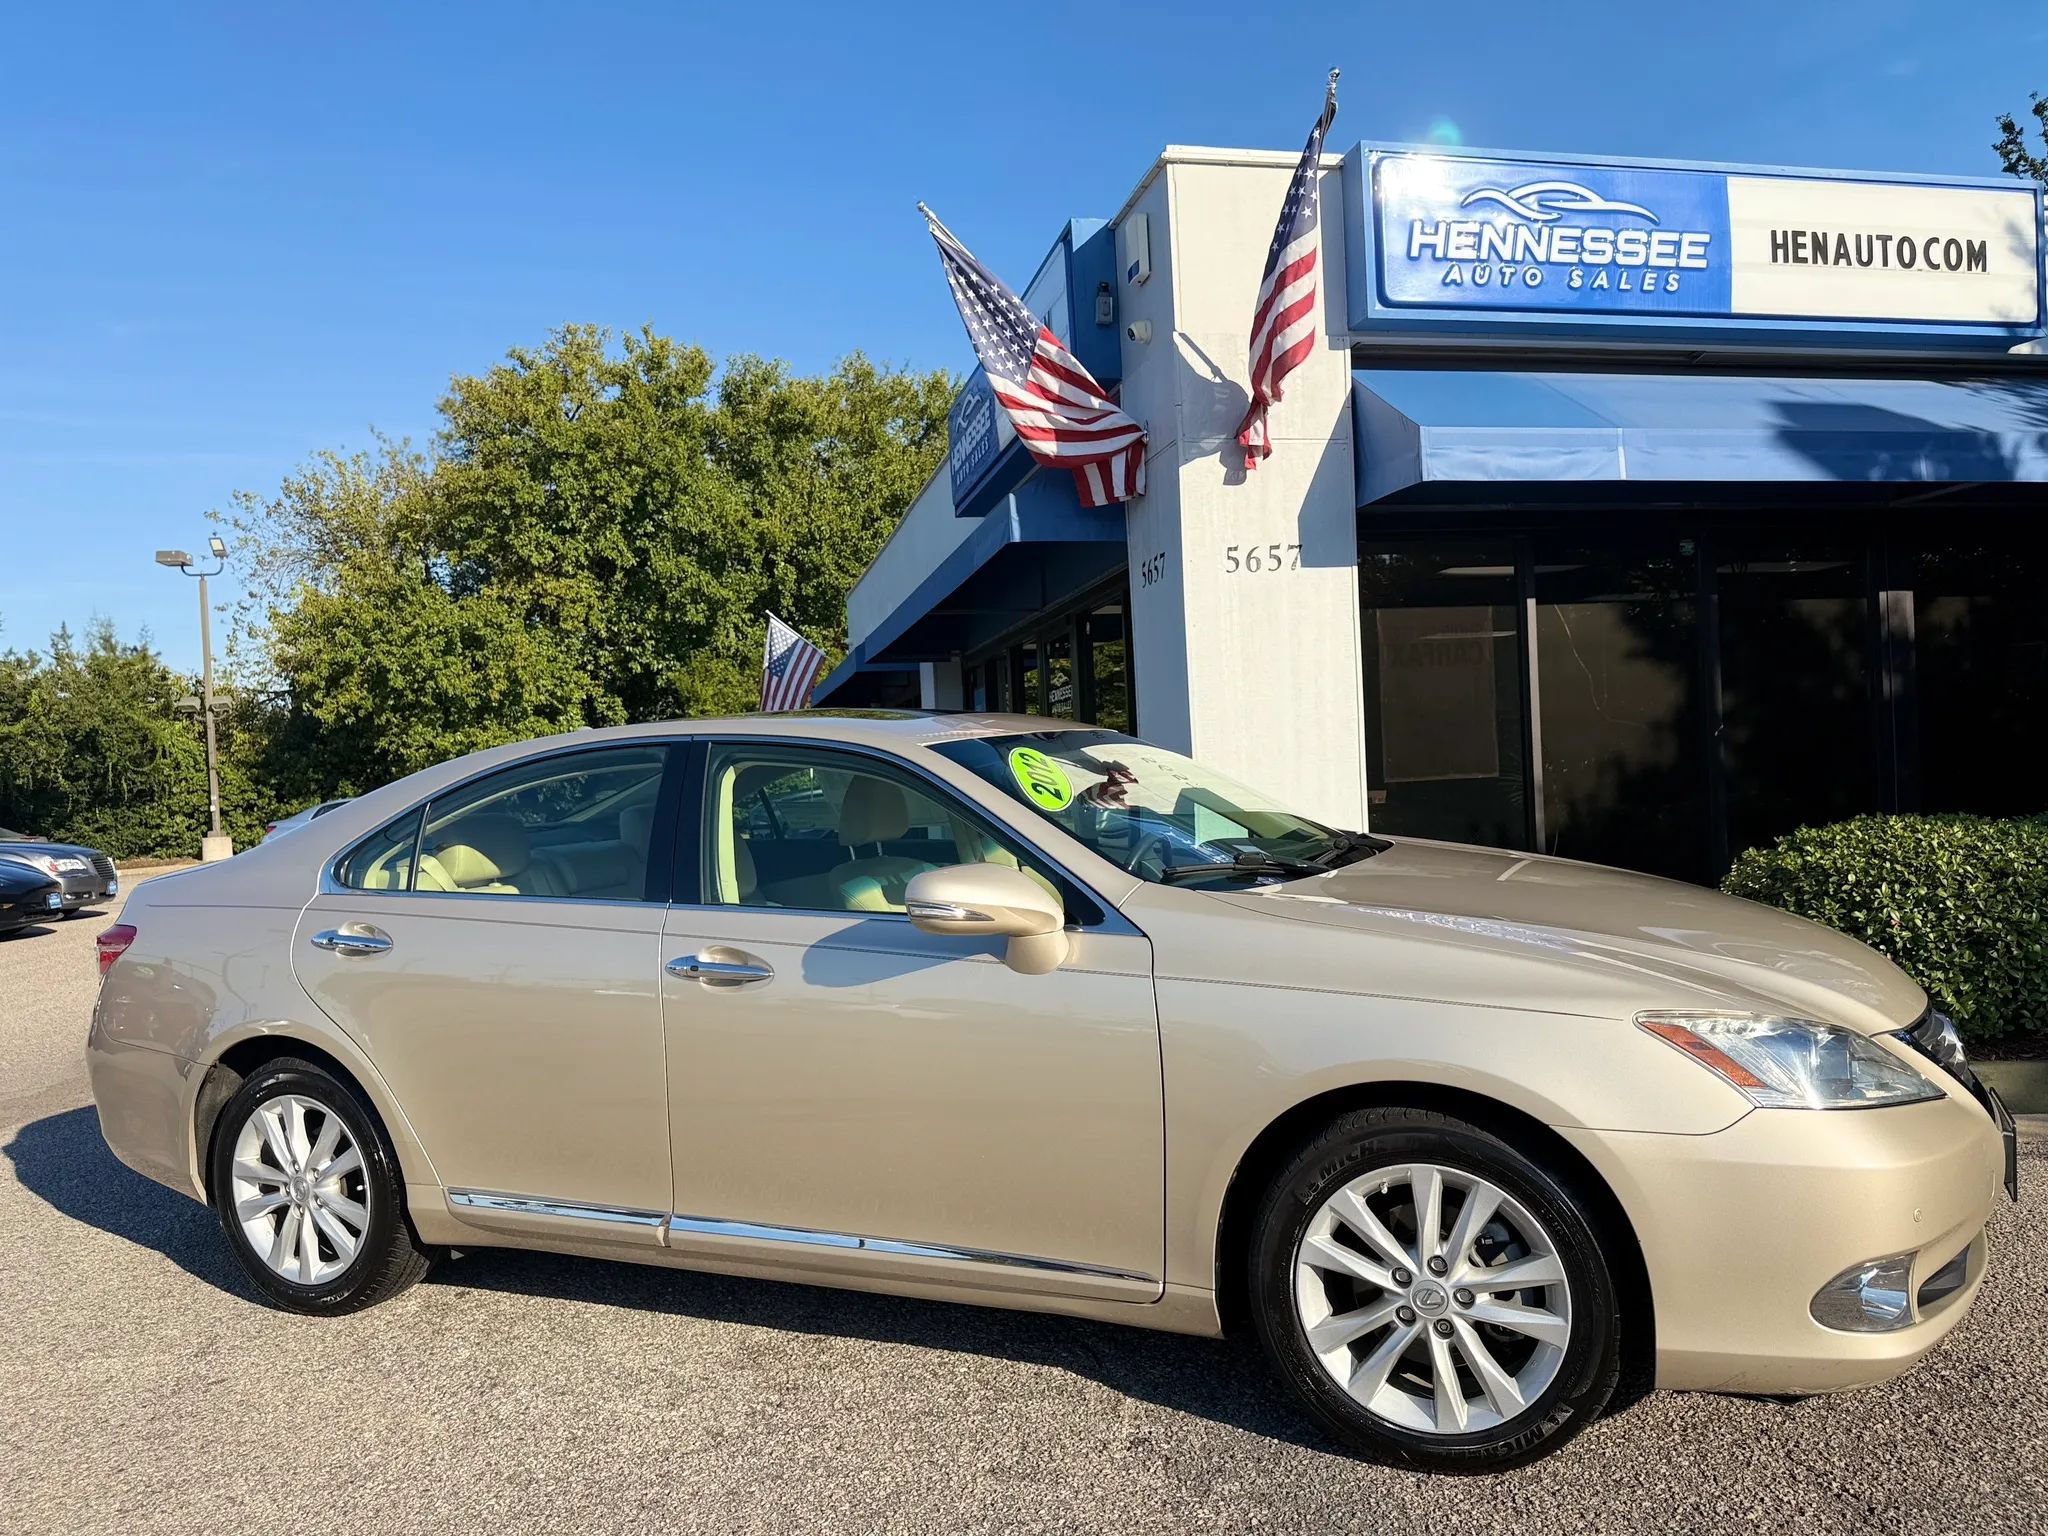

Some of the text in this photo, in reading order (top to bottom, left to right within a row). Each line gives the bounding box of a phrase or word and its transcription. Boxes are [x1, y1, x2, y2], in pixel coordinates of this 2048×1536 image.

[1408, 219, 1711, 270] HENNESSEE
[1444, 264, 1680, 291] AUTO SALES
[1142, 552, 1166, 588] 5657
[1226, 544, 1303, 574] 5657
[1018, 753, 1063, 801] 2012
